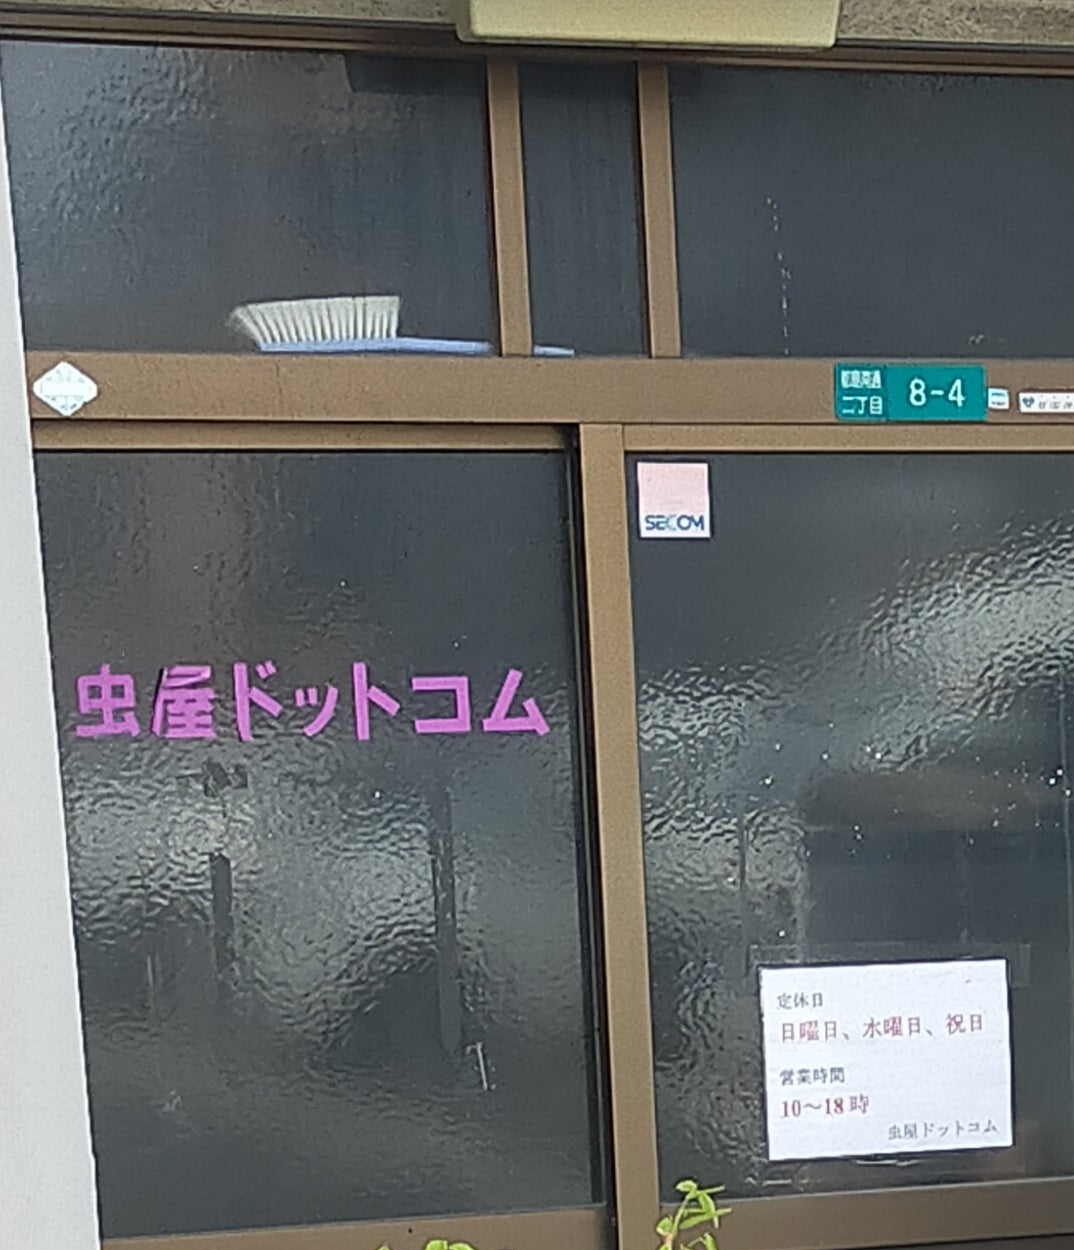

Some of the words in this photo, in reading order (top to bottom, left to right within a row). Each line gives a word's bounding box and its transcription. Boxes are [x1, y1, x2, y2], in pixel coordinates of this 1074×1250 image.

[908, 377, 967, 409] 8-4
[644, 514, 705, 531] SECOM
[75, 660, 551, 742] 虫屋ドットコム
[777, 992, 824, 1010] 定休日
[779, 1066, 846, 1086] 営業時間
[887, 1118, 1000, 1141] 虫屋ドットコム
